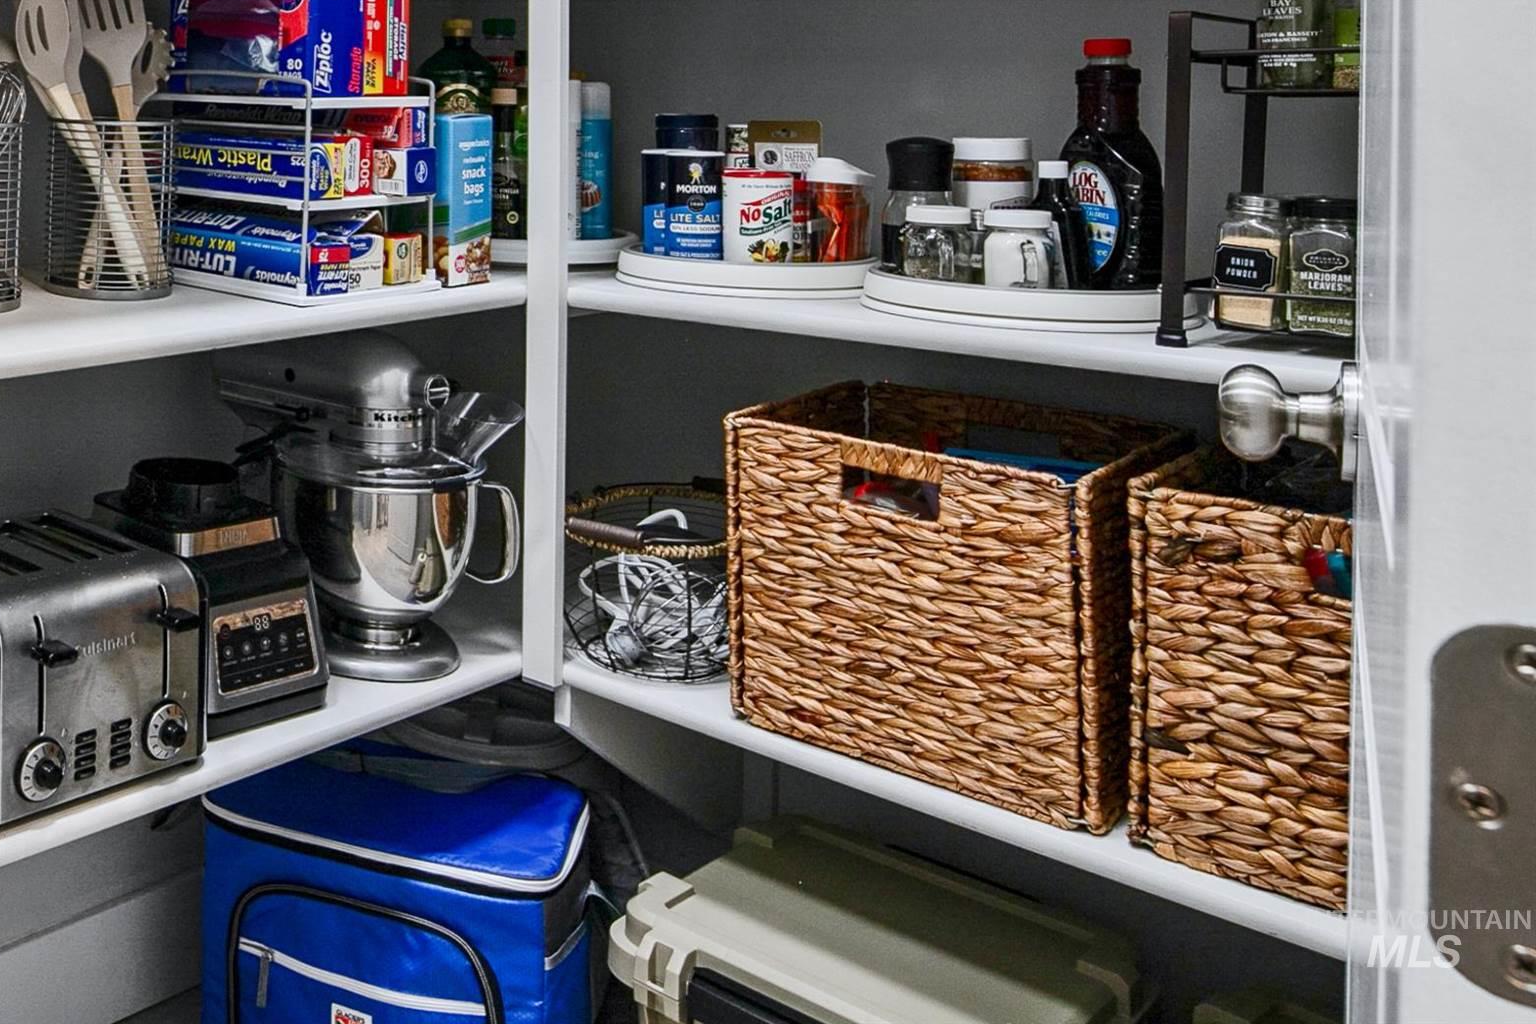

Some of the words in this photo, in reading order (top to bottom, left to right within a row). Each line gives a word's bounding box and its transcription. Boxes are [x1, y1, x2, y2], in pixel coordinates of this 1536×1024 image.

[1270, 0, 1292, 7] BAY
[1262, 6, 1303, 16] LEAVES
[286, 58, 303, 70] 80
[315, 32, 333, 88] Ziploc
[348, 47, 362, 94] Storage
[217, 148, 272, 171] Plastic
[784, 152, 815, 162] SAFFRON
[360, 158, 370, 189] 300
[461, 165, 487, 179] snack
[1072, 172, 1098, 188] LOG
[464, 181, 485, 197] bags
[676, 184, 717, 193] MORTON
[1075, 187, 1107, 205] ABIN
[670, 213, 693, 222] LITE
[695, 214, 721, 223] SALT
[170, 232, 205, 247] PAPE
[208, 237, 236, 252] WAX
[170, 247, 237, 276] CUT-RIT
[1230, 256, 1255, 268] ONION
[1225, 267, 1258, 279] POWDER
[1300, 271, 1353, 283] MARJORAM
[1308, 280, 1344, 292] LEAVES
[254, 615, 270, 632] 88
